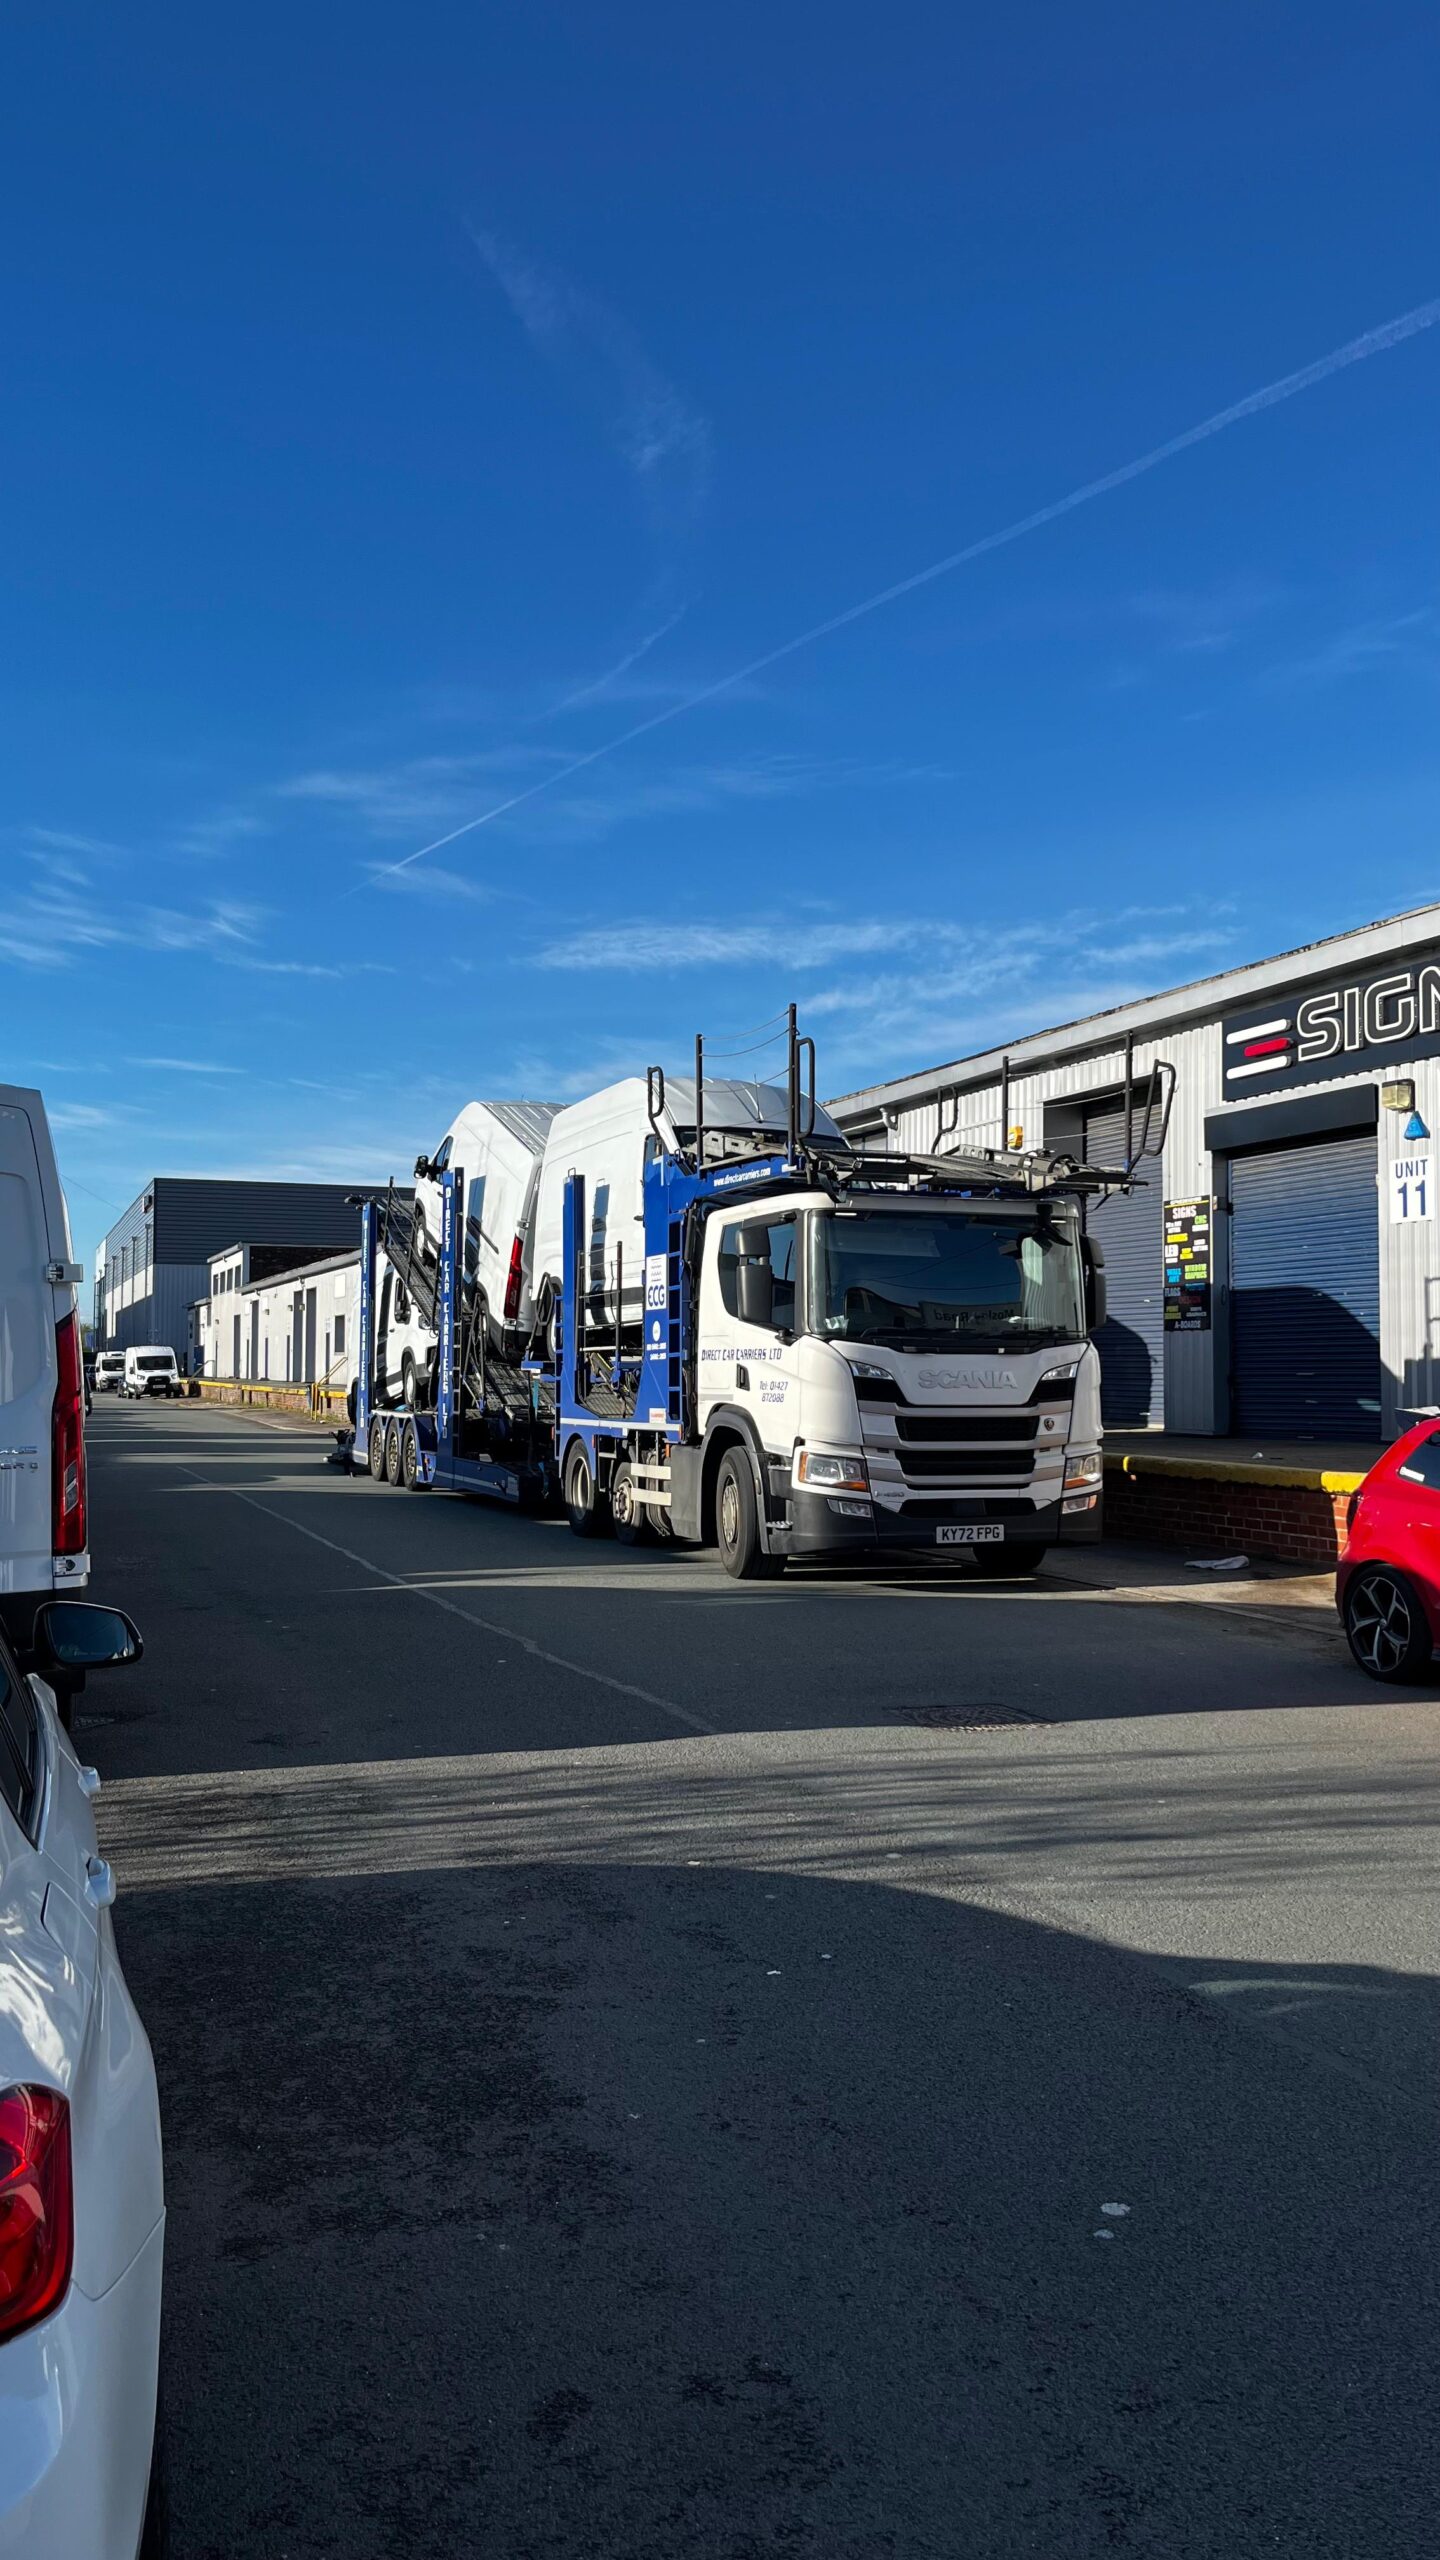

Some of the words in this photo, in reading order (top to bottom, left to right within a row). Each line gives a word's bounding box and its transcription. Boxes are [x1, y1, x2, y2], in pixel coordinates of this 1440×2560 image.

[1395, 1159, 1428, 1179] UNIT
[1397, 1180, 1426, 1217] 11
[444, 1187, 452, 1252] DIRECT
[1172, 1205, 1197, 1219] SIGNS
[647, 1284, 665, 1307] ECG
[1174, 1320, 1201, 1329] A-BOARDS
[701, 1349, 721, 1361] DIRECT
[722, 1349, 735, 1361] CAR
[736, 1348, 767, 1361] CARRIERS
[768, 1348, 782, 1360] LTD
[770, 1381, 788, 1391] 01427
[918, 1369, 1018, 1389] SCANIA
[941, 1527, 974, 1541] KY72
[976, 1526, 1000, 1540] FPG
